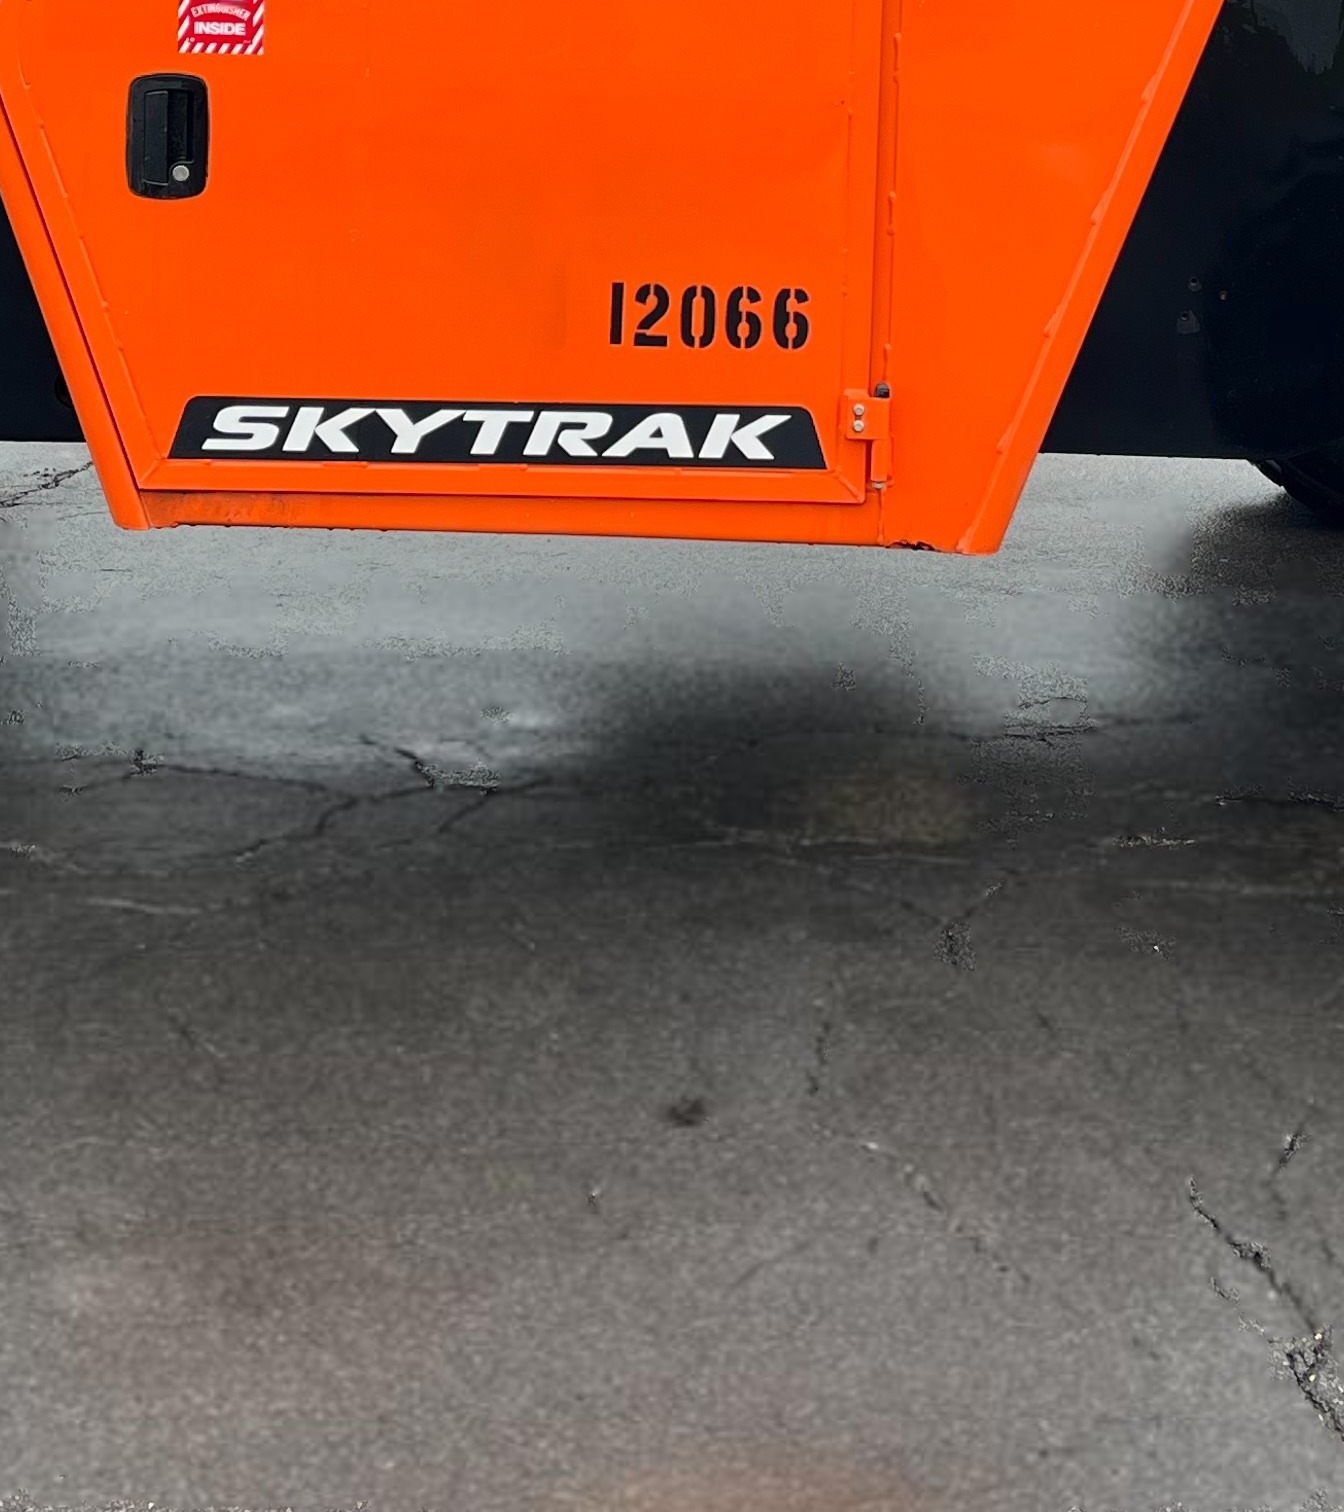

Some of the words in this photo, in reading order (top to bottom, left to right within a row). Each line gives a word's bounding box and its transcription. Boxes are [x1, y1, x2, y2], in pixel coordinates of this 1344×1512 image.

[194, 22, 246, 36] INSIDE
[609, 281, 810, 351] 12066
[200, 405, 794, 460] SKYTRAK
